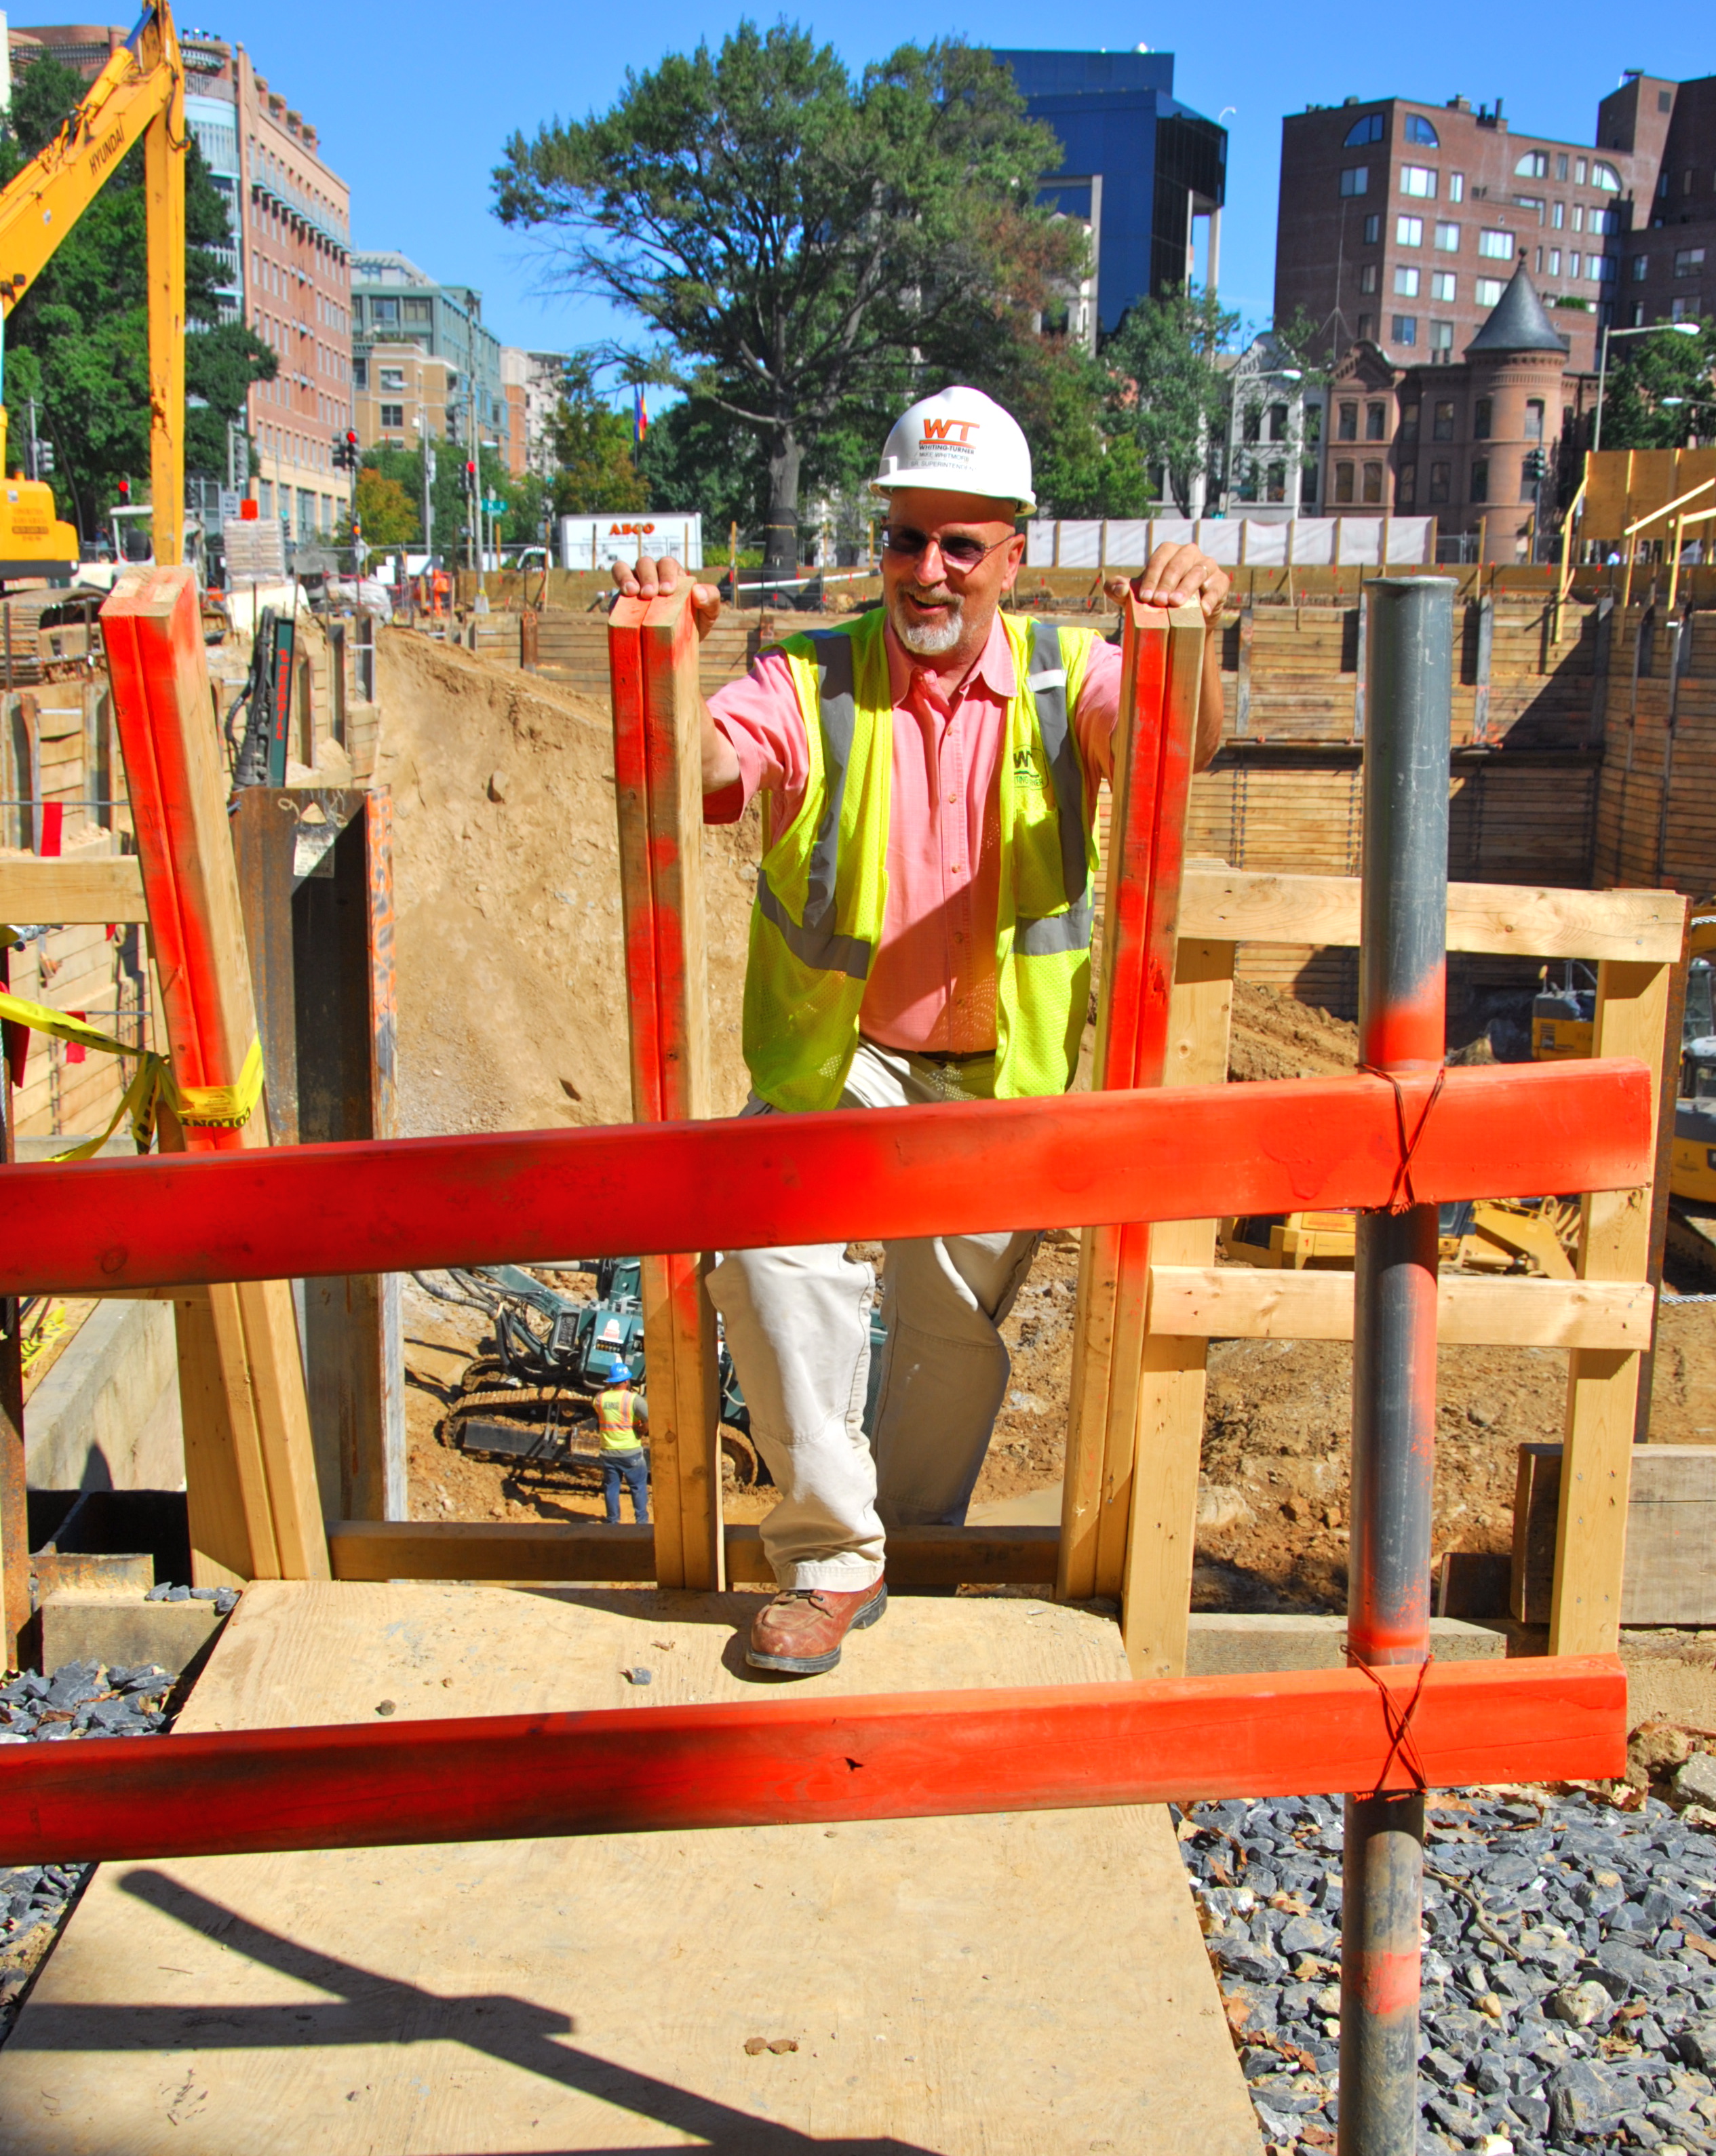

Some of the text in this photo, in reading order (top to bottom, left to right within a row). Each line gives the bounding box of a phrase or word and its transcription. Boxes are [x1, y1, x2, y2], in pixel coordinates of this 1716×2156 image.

[89, 125, 125, 176] HYUNDAI
[923, 418, 980, 441] WT
[918, 444, 975, 455] WHITING-TURNER
[935, 452, 969, 463] WHITMORE
[921, 461, 977, 471] SUPERINTENDEN
[180, 1106, 251, 1128] COLONY
